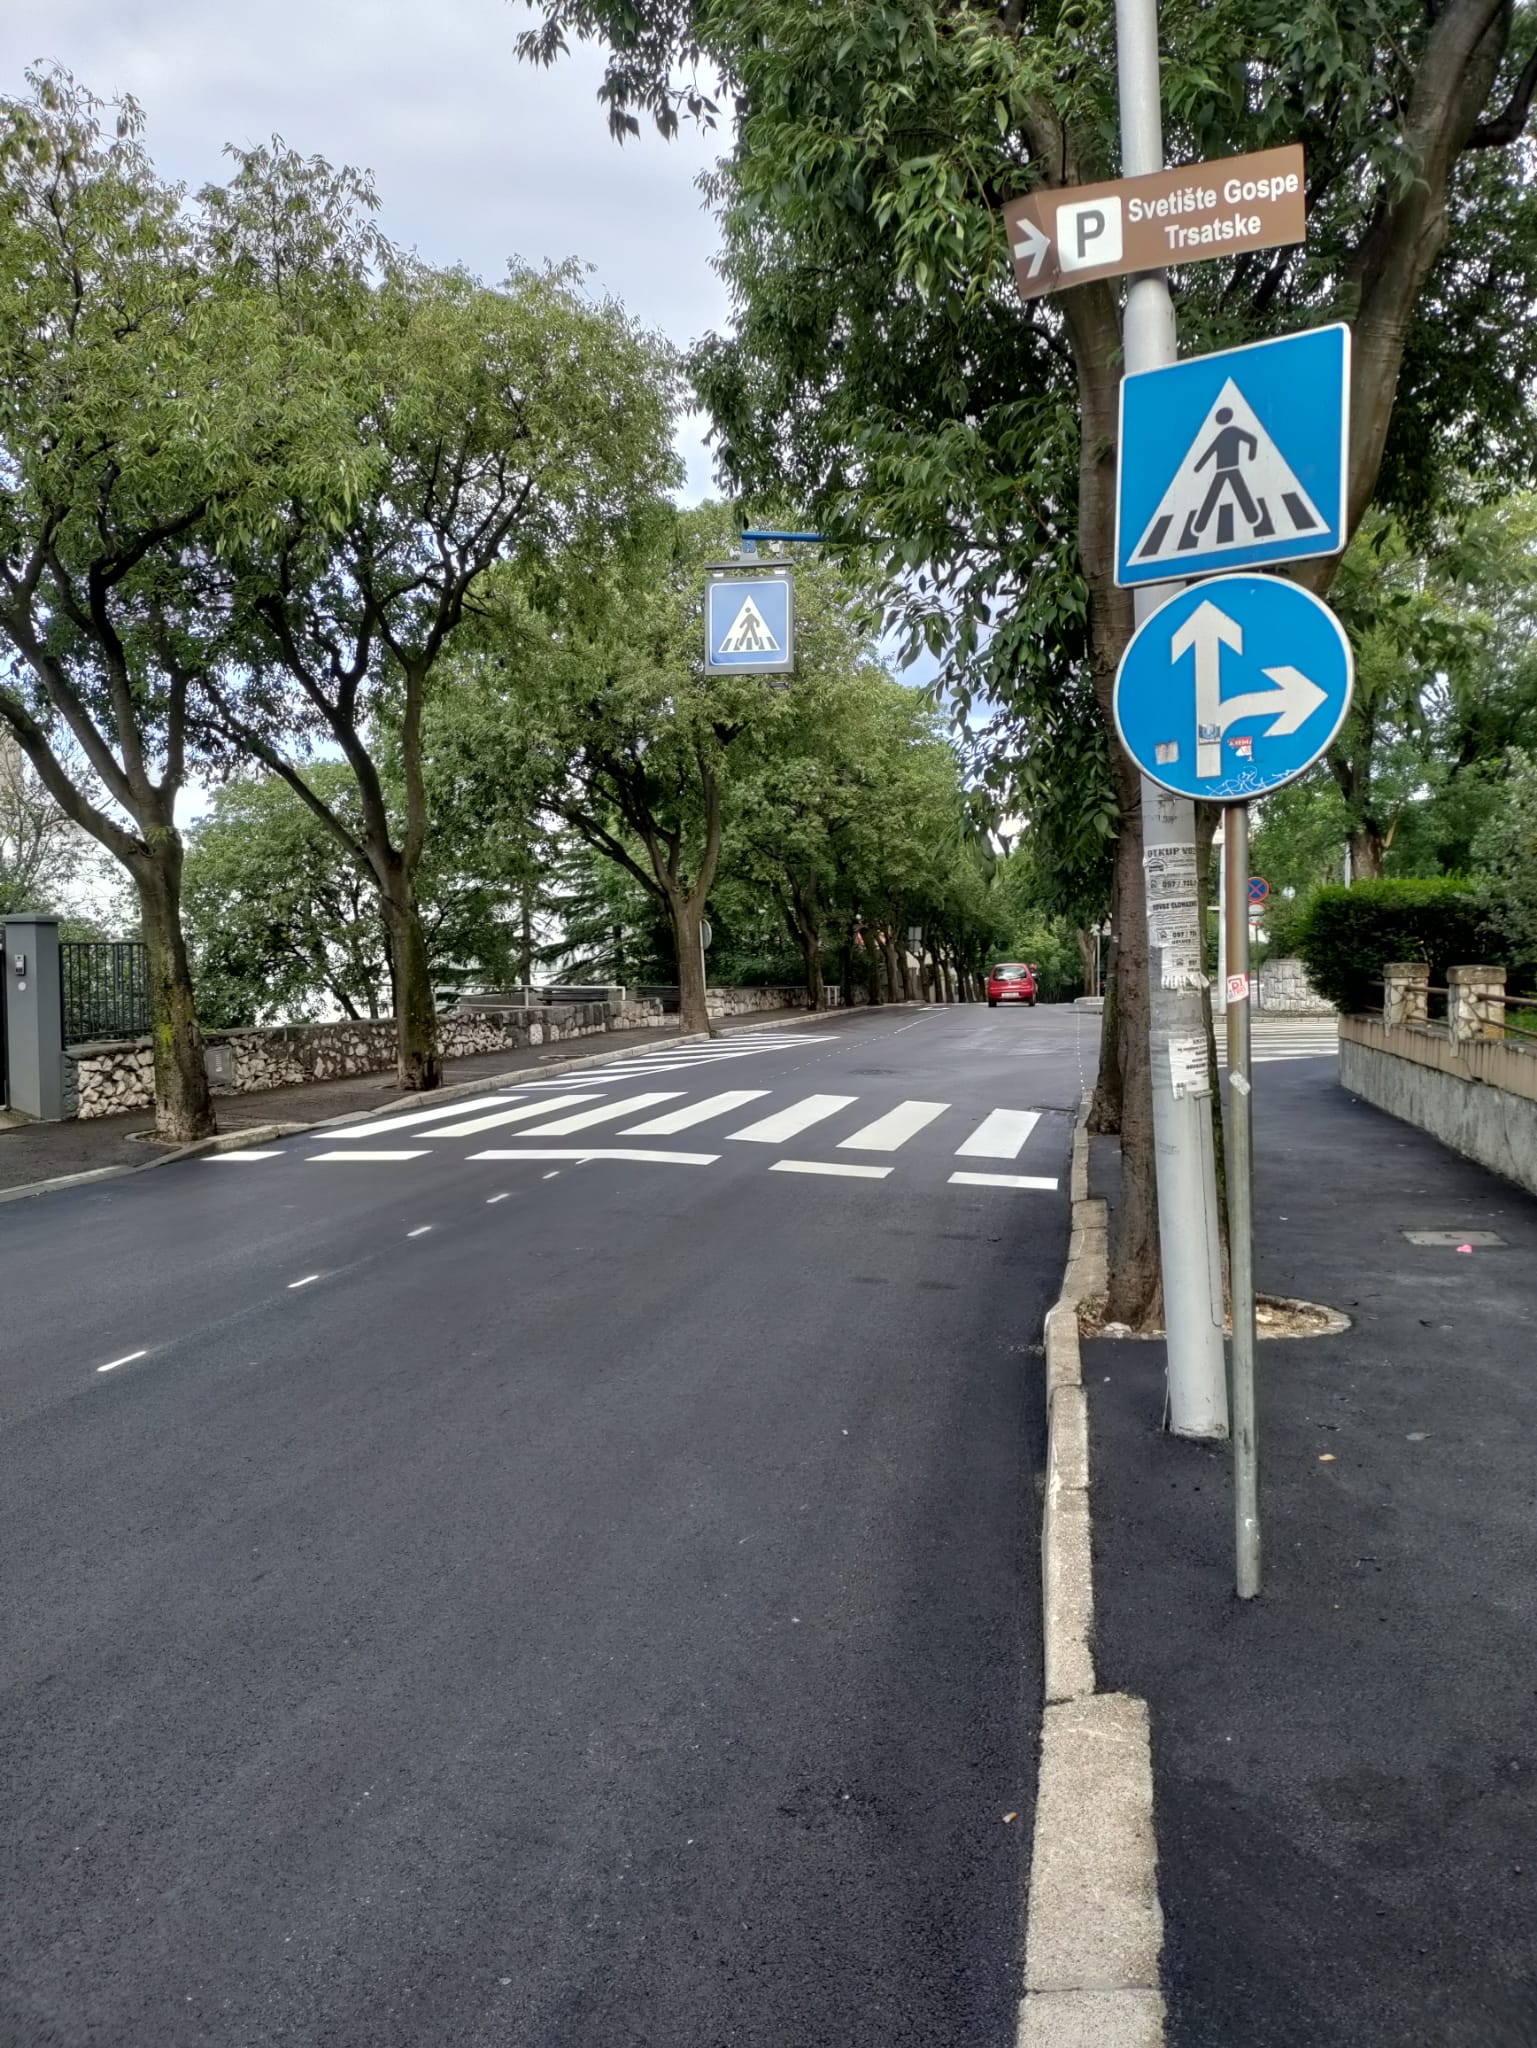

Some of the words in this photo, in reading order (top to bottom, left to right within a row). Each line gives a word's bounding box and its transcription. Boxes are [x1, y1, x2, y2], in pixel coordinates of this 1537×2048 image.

[1128, 187, 1217, 222] Svetište
[1223, 173, 1299, 204] Gospe
[1076, 209, 1105, 258] P
[1164, 213, 1262, 249] Trsatske
